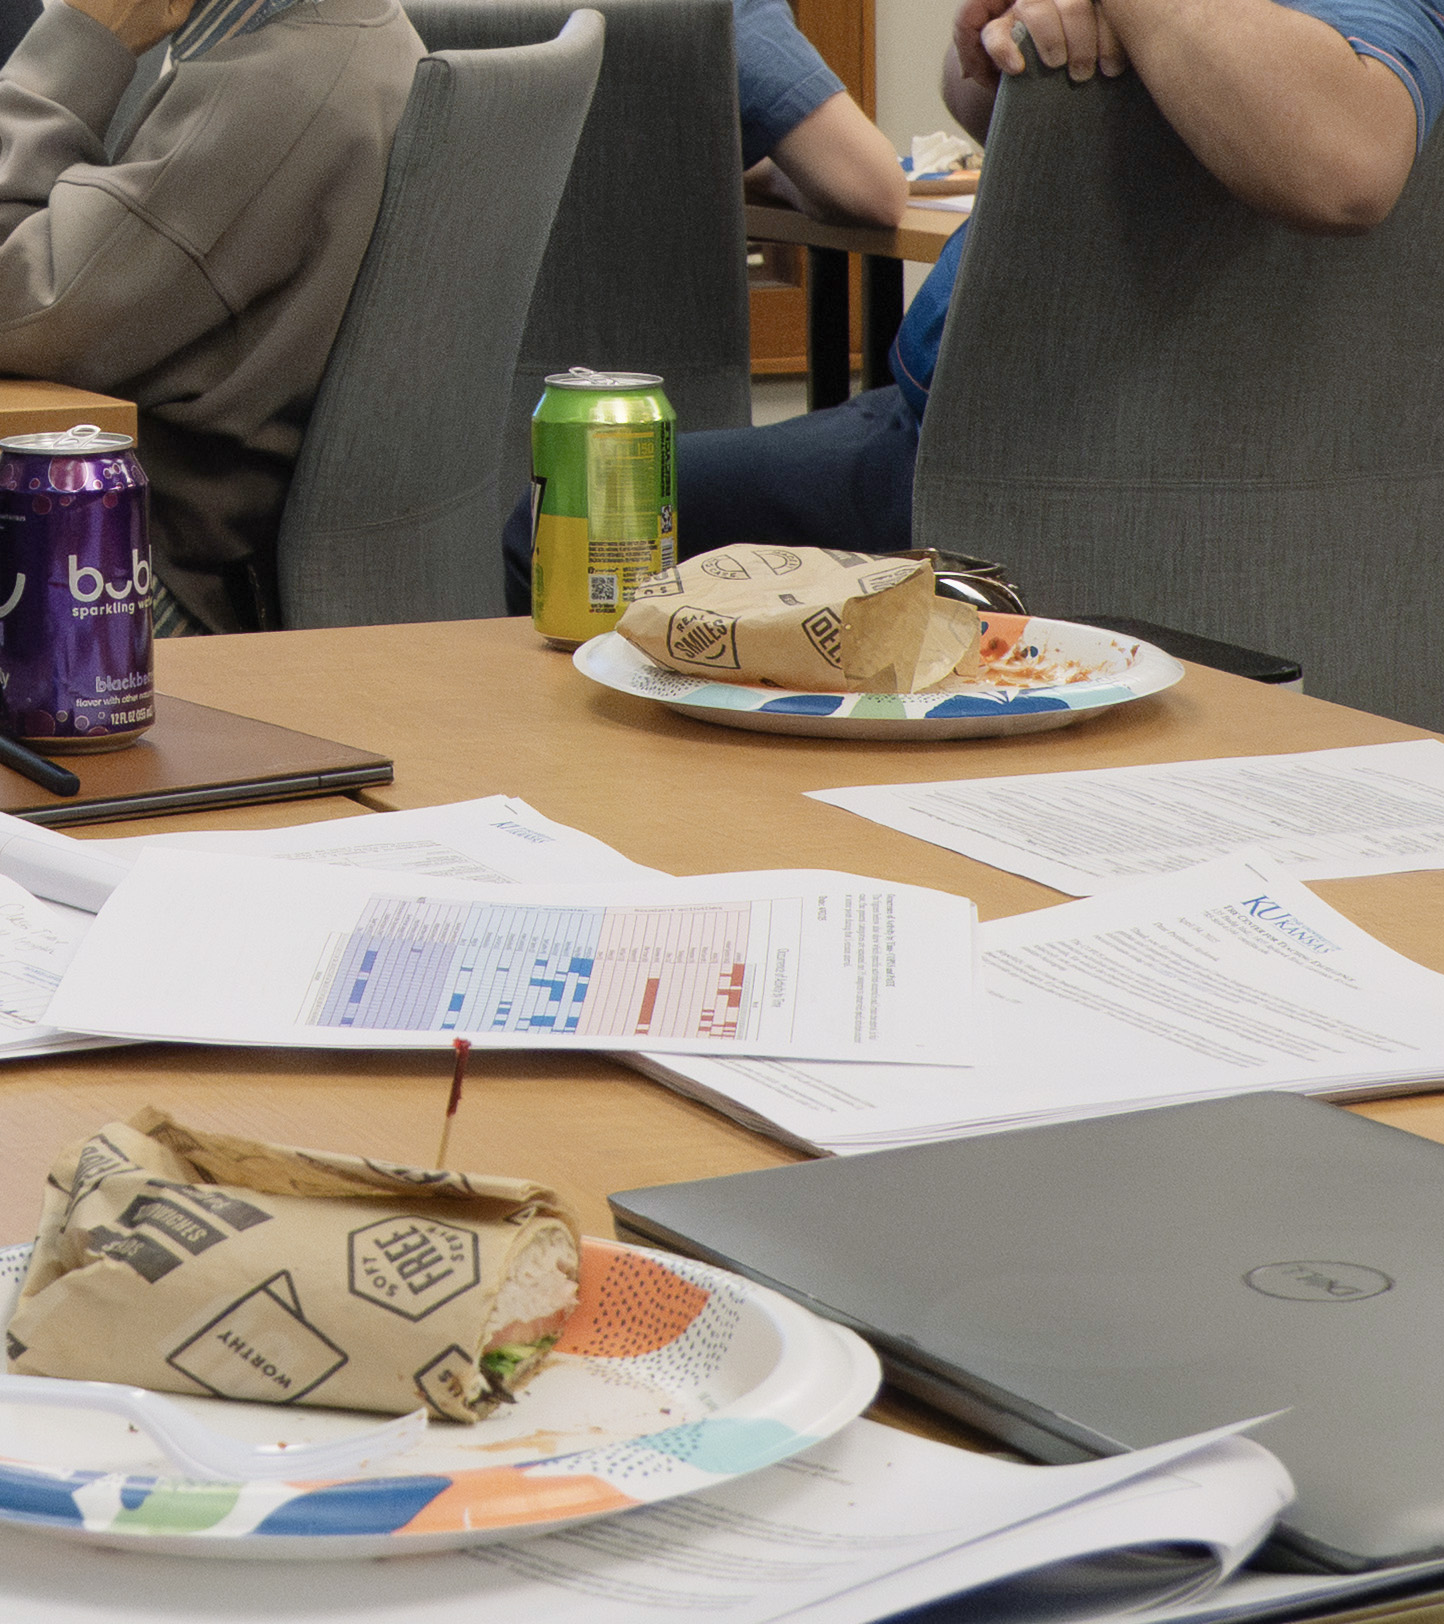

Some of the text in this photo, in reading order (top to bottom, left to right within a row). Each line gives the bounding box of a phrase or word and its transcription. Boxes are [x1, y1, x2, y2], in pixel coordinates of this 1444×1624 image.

[72, 601, 135, 620] sparkling
[673, 618, 728, 659] SMILES
[1241, 893, 1292, 923] KU
[1275, 919, 1330, 955] KANSAS
[362, 1254, 399, 1298] SOFT
[373, 1225, 455, 1296] FREE
[216, 1329, 294, 1390] WORTHY
